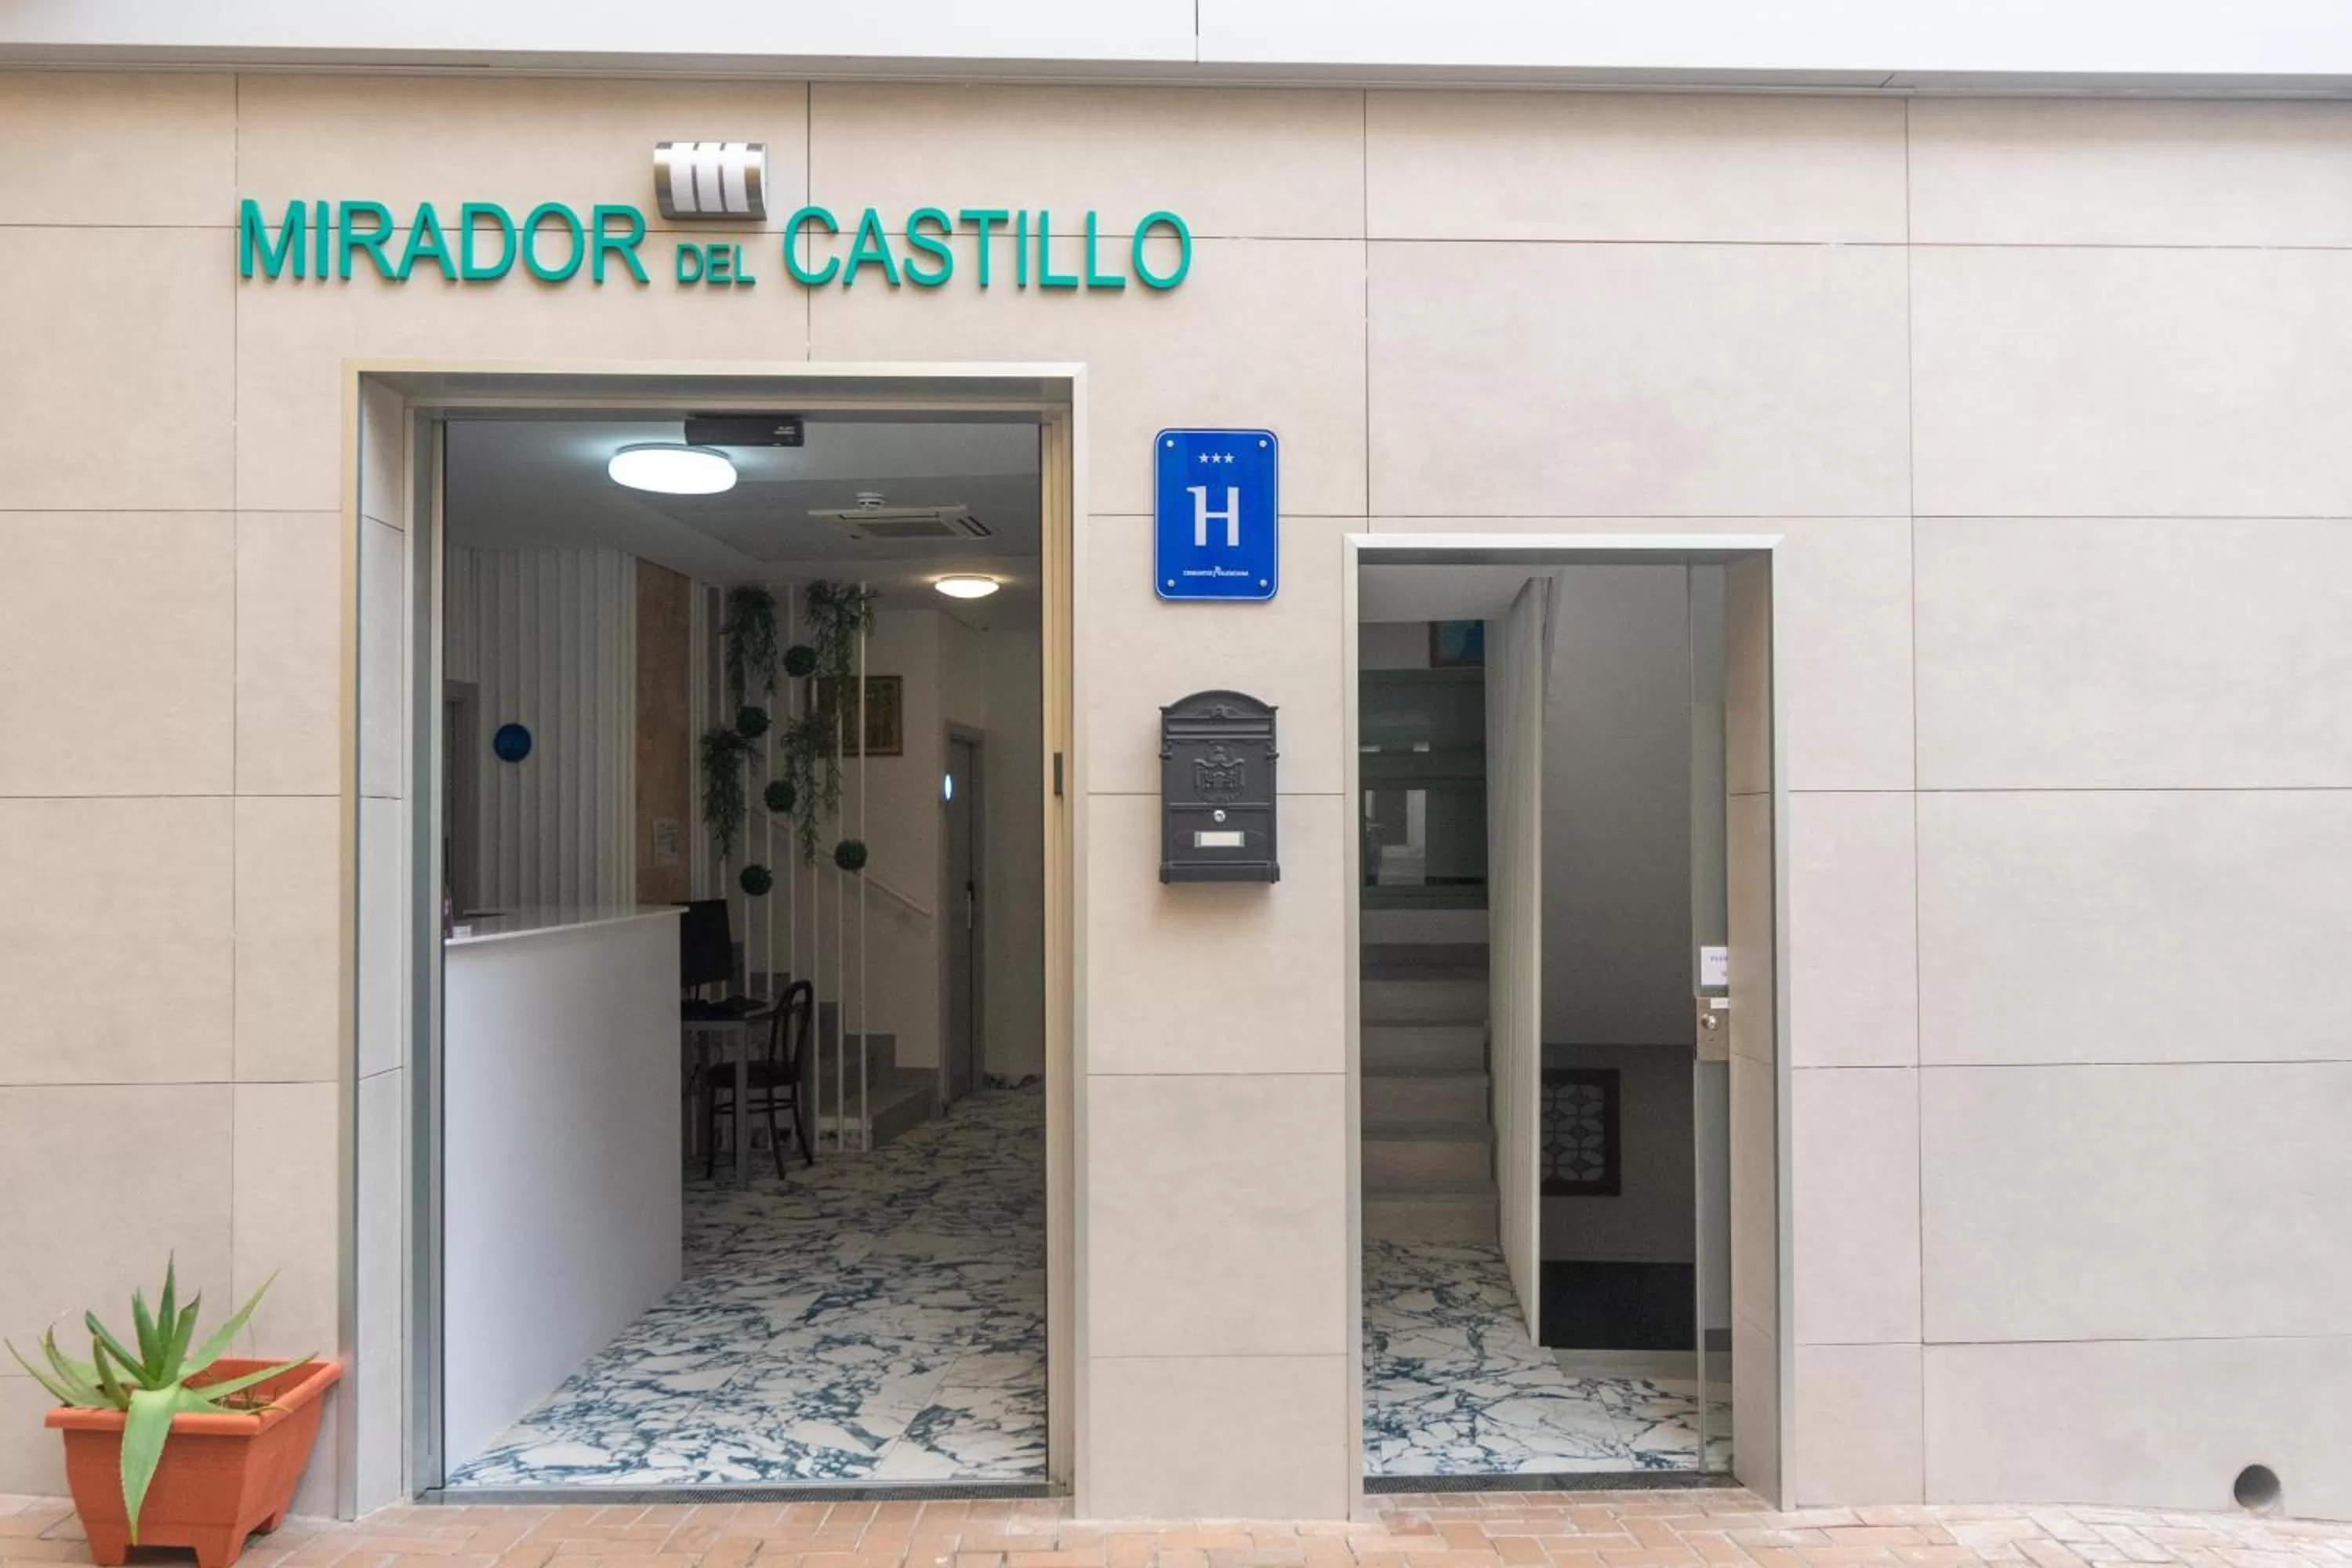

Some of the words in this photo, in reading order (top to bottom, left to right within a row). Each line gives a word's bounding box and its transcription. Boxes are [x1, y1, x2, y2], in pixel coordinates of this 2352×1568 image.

[239, 198, 650, 285] MIRADOR
[675, 243, 756, 285] DEL
[782, 205, 1192, 291] CASTILLO
[1186, 485, 1240, 546] H
